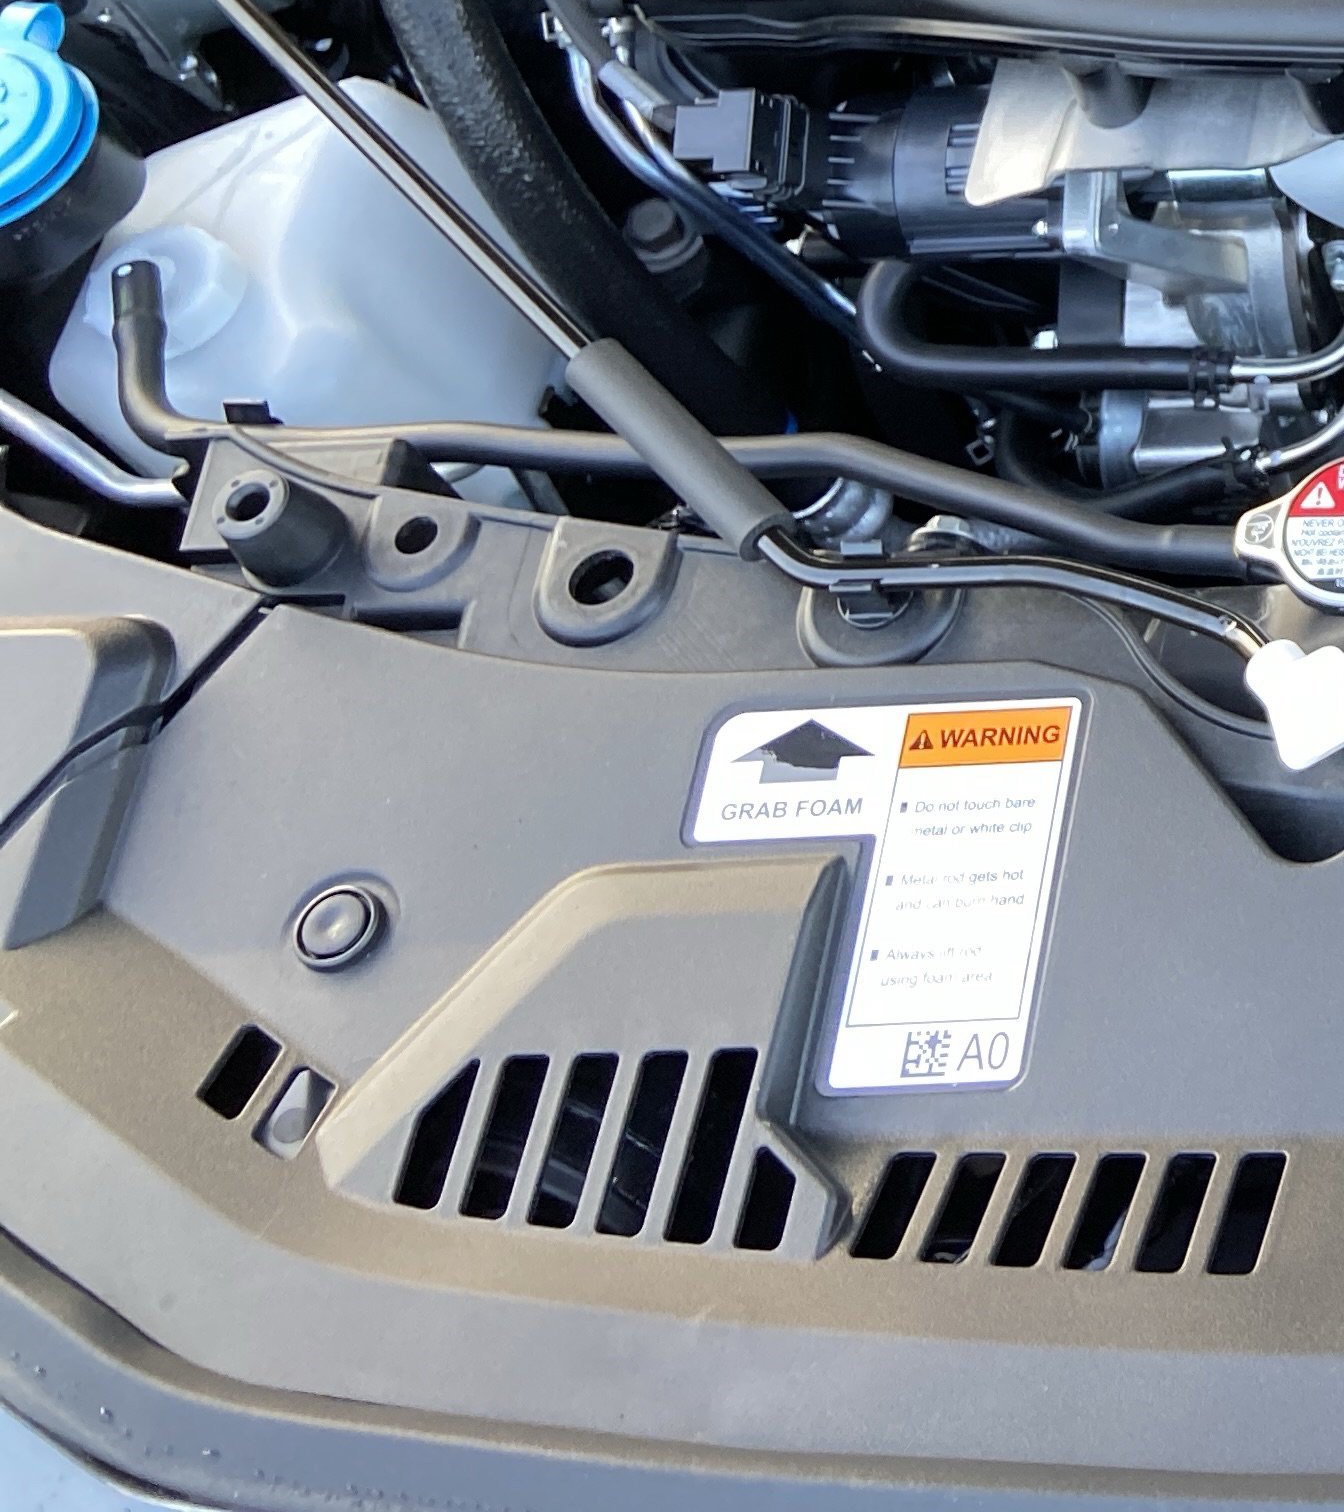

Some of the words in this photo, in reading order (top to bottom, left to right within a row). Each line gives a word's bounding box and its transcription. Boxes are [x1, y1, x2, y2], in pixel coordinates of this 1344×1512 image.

[1302, 518, 1334, 528] NEVER
[940, 724, 1062, 749] WARNING
[721, 801, 788, 821] GRAB
[795, 797, 863, 817] FOAM
[914, 800, 934, 813] Do
[938, 800, 960, 812] not
[963, 798, 1001, 811] touch
[1005, 797, 1036, 809] bare
[951, 824, 965, 835] or
[969, 821, 1005, 834] white
[1009, 821, 1033, 837] clip
[968, 871, 999, 885] gets
[1002, 869, 1024, 881] hot
[990, 894, 1025, 906] hand
[956, 1031, 1010, 1072] A0
